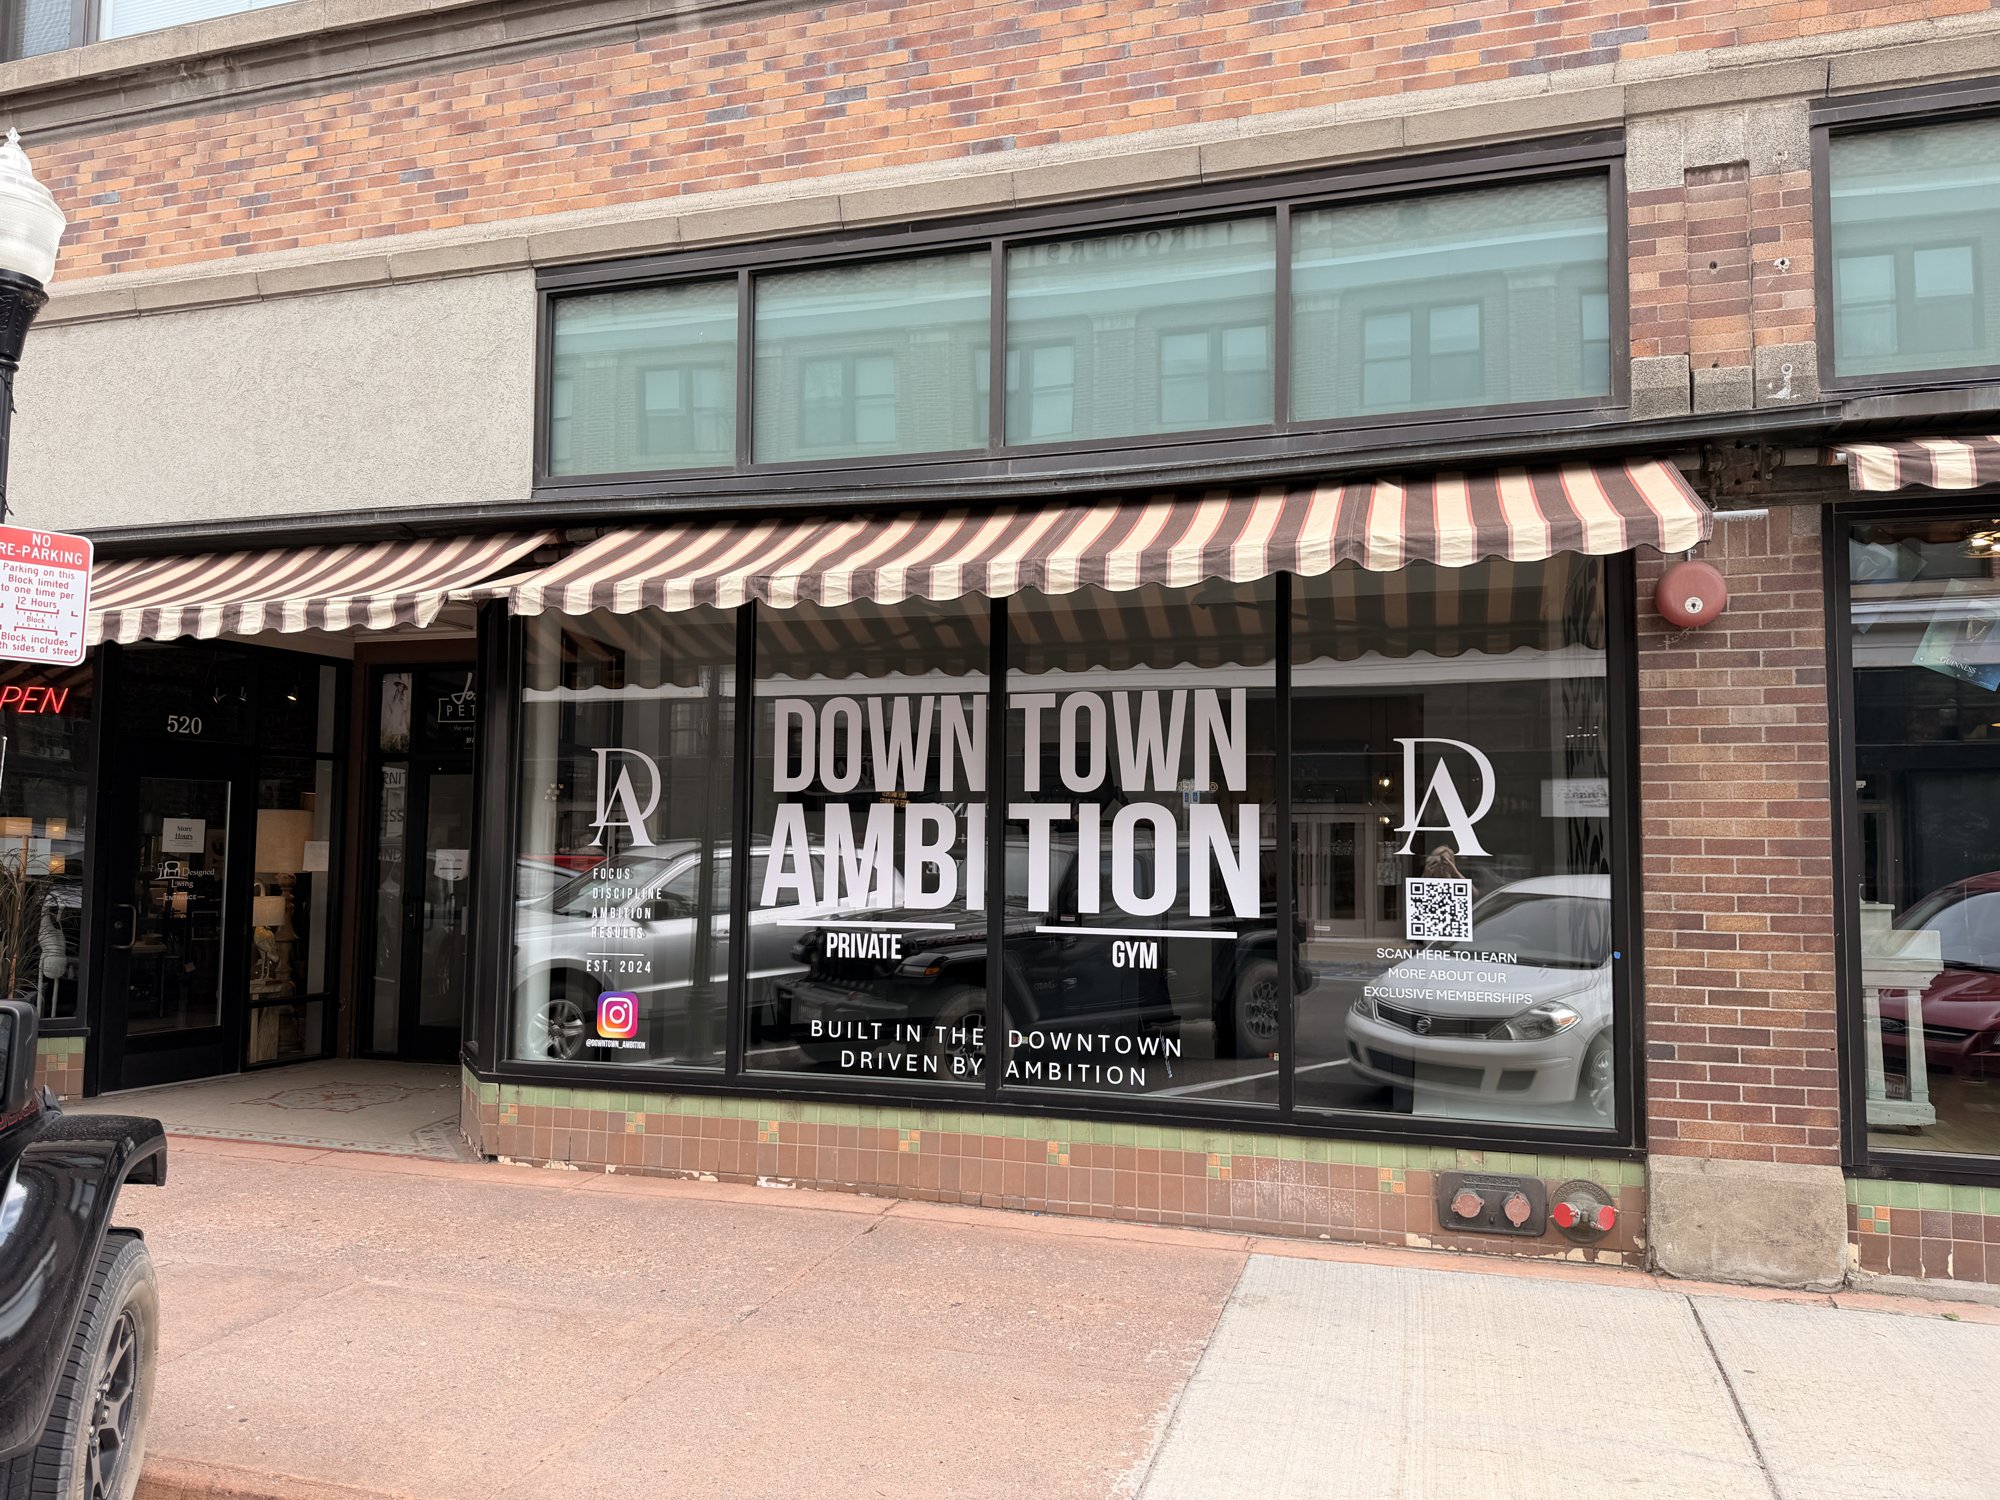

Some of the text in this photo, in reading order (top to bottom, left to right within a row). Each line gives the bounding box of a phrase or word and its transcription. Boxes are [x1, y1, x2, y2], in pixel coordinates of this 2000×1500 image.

[32, 533, 52, 547] NO
[3, 562, 75, 580] Parking on this
[8, 574, 69, 590] Block limited
[1, 583, 74, 600] to one time per
[17, 596, 57, 609] 12 Hours
[26, 615, 46, 624] Block
[1, 631, 69, 647] Block includes
[12, 643, 35, 652] sides
[39, 645, 49, 654] of
[52, 647, 78, 657] street
[1940, 656, 1977, 674] GUINNESS
[167, 714, 203, 735] 520
[182, 867, 215, 877] Designed
[593, 867, 631, 880] FOCUS
[171, 879, 194, 889] Living
[592, 887, 662, 900] DISCIPLINE
[592, 907, 652, 919] AMBITION
[591, 926, 643, 939] RESULTS
[826, 933, 903, 960] PRIVATE
[1112, 941, 1158, 970] GYM
[1376, 948, 1517, 964] SCAN HERE TO LEARN
[586, 959, 651, 973] EST. 2024
[1388, 968, 1507, 983] MORE ABOUT OUR
[1364, 986, 1533, 1005] EXCLUSIVE MEMBERSHIPS
[810, 1020, 1182, 1058] BUILT IN THE DOWNTOWN
[841, 1050, 1146, 1086] DRIVEN BY AMBITION
